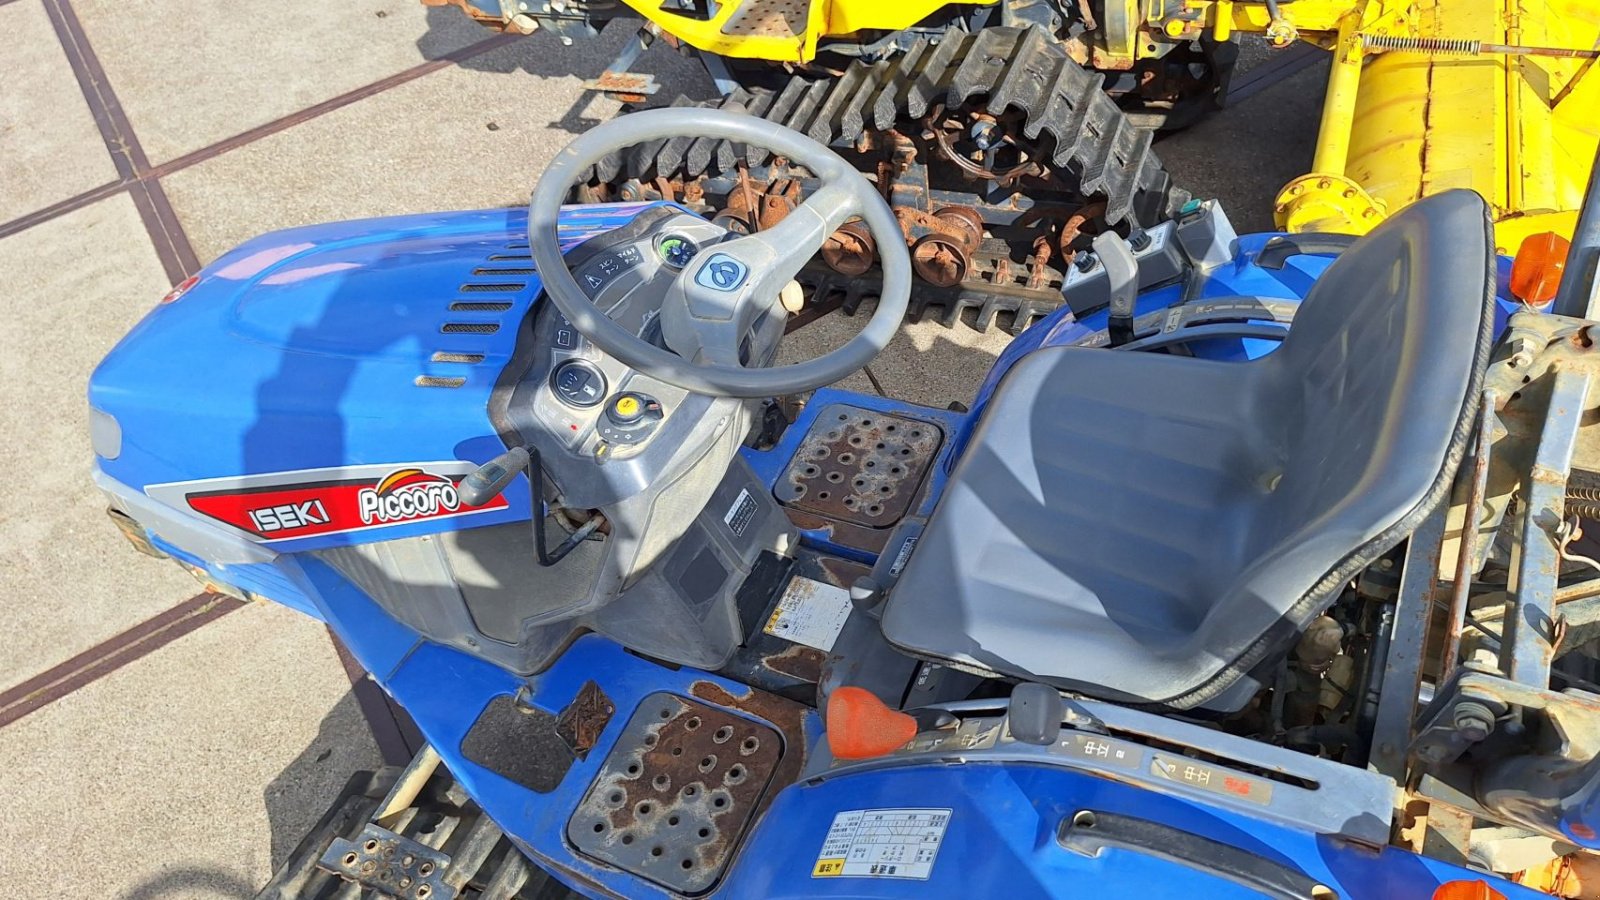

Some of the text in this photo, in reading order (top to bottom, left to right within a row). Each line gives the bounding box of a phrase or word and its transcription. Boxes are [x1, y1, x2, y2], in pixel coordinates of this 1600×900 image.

[598, 258, 613, 270] スピン
[624, 255, 639, 265] ターン
[605, 264, 619, 276] ターン
[248, 482, 460, 532] ISEKI Piccoro
[1084, 741, 1110, 758] 中立
[1116, 750, 1125, 759] 2
[1183, 766, 1211, 785] 中立
